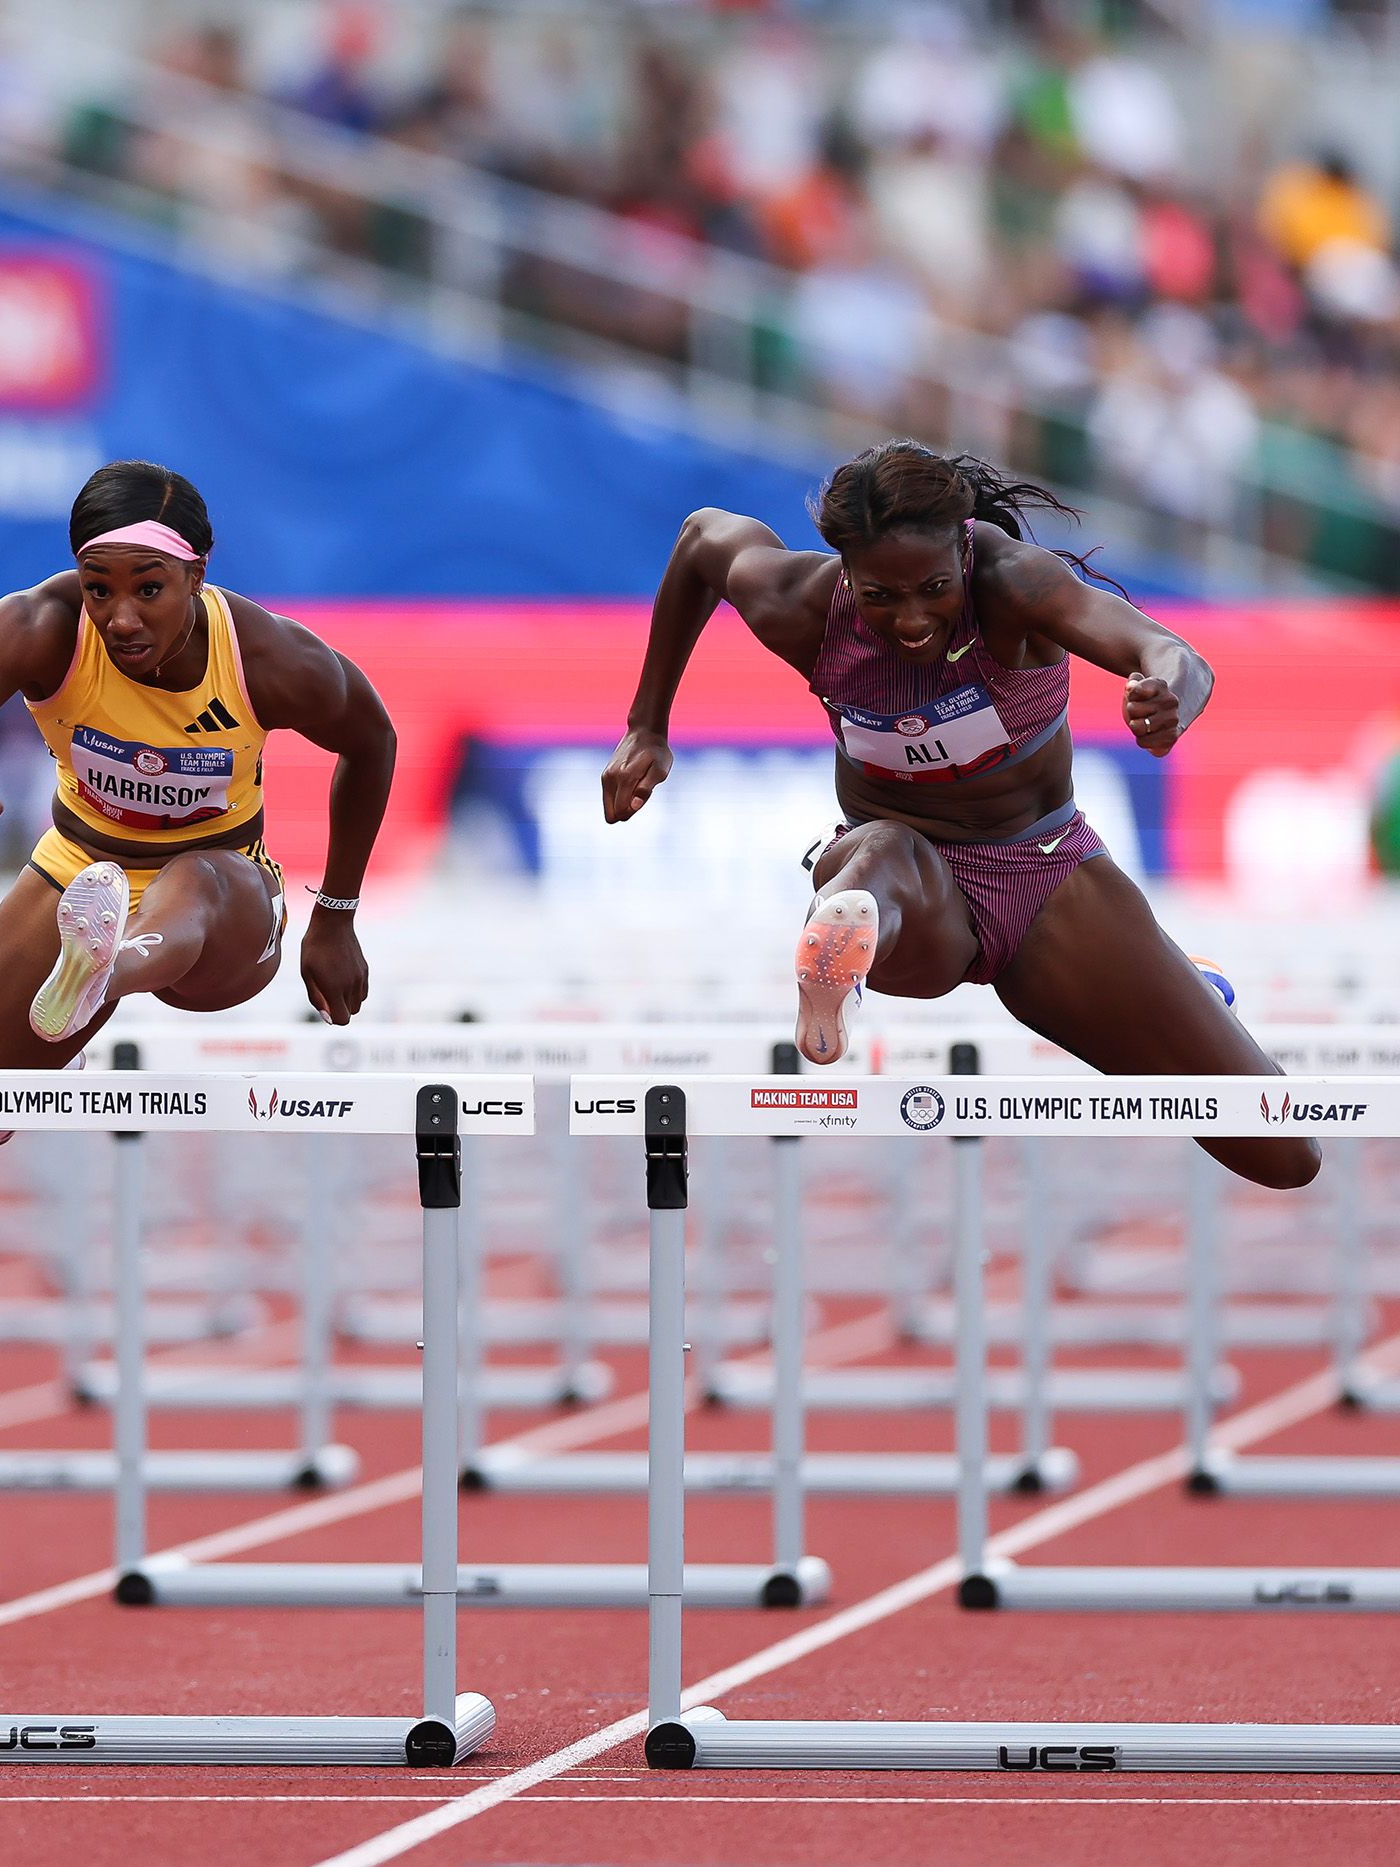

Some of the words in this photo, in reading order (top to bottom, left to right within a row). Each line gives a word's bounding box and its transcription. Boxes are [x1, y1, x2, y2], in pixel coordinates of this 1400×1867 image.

[948, 687, 977, 704] OLYMPIC
[936, 703, 956, 716] TEAM
[955, 693, 980, 708] TRIALS
[94, 740, 125, 755] USATF
[180, 752, 194, 760] U.S.
[195, 752, 226, 760] OLYMPIC
[904, 740, 950, 765] ALI
[180, 759, 200, 767] TEAM
[201, 760, 226, 768] TRIALS
[88, 768, 211, 807] HARRISON
[79, 1091, 132, 1114] TEAM
[139, 1091, 207, 1115] TRIALS
[574, 1100, 636, 1114] UCS
[754, 1092, 797, 1105] MAKING
[799, 1093, 828, 1105] TEAM
[831, 1093, 854, 1106] USA
[279, 1100, 354, 1117] USATF
[462, 1101, 524, 1116] UCS
[956, 1097, 992, 1120] U.S.
[999, 1097, 1082, 1120] OLYMPIC
[1089, 1097, 1142, 1120] TEAM
[1149, 1097, 1218, 1120] TRIALS
[1292, 1104, 1367, 1121] USATF
[818, 1114, 857, 1128] xfinity
[1000, 1746, 1116, 1770] UCS
